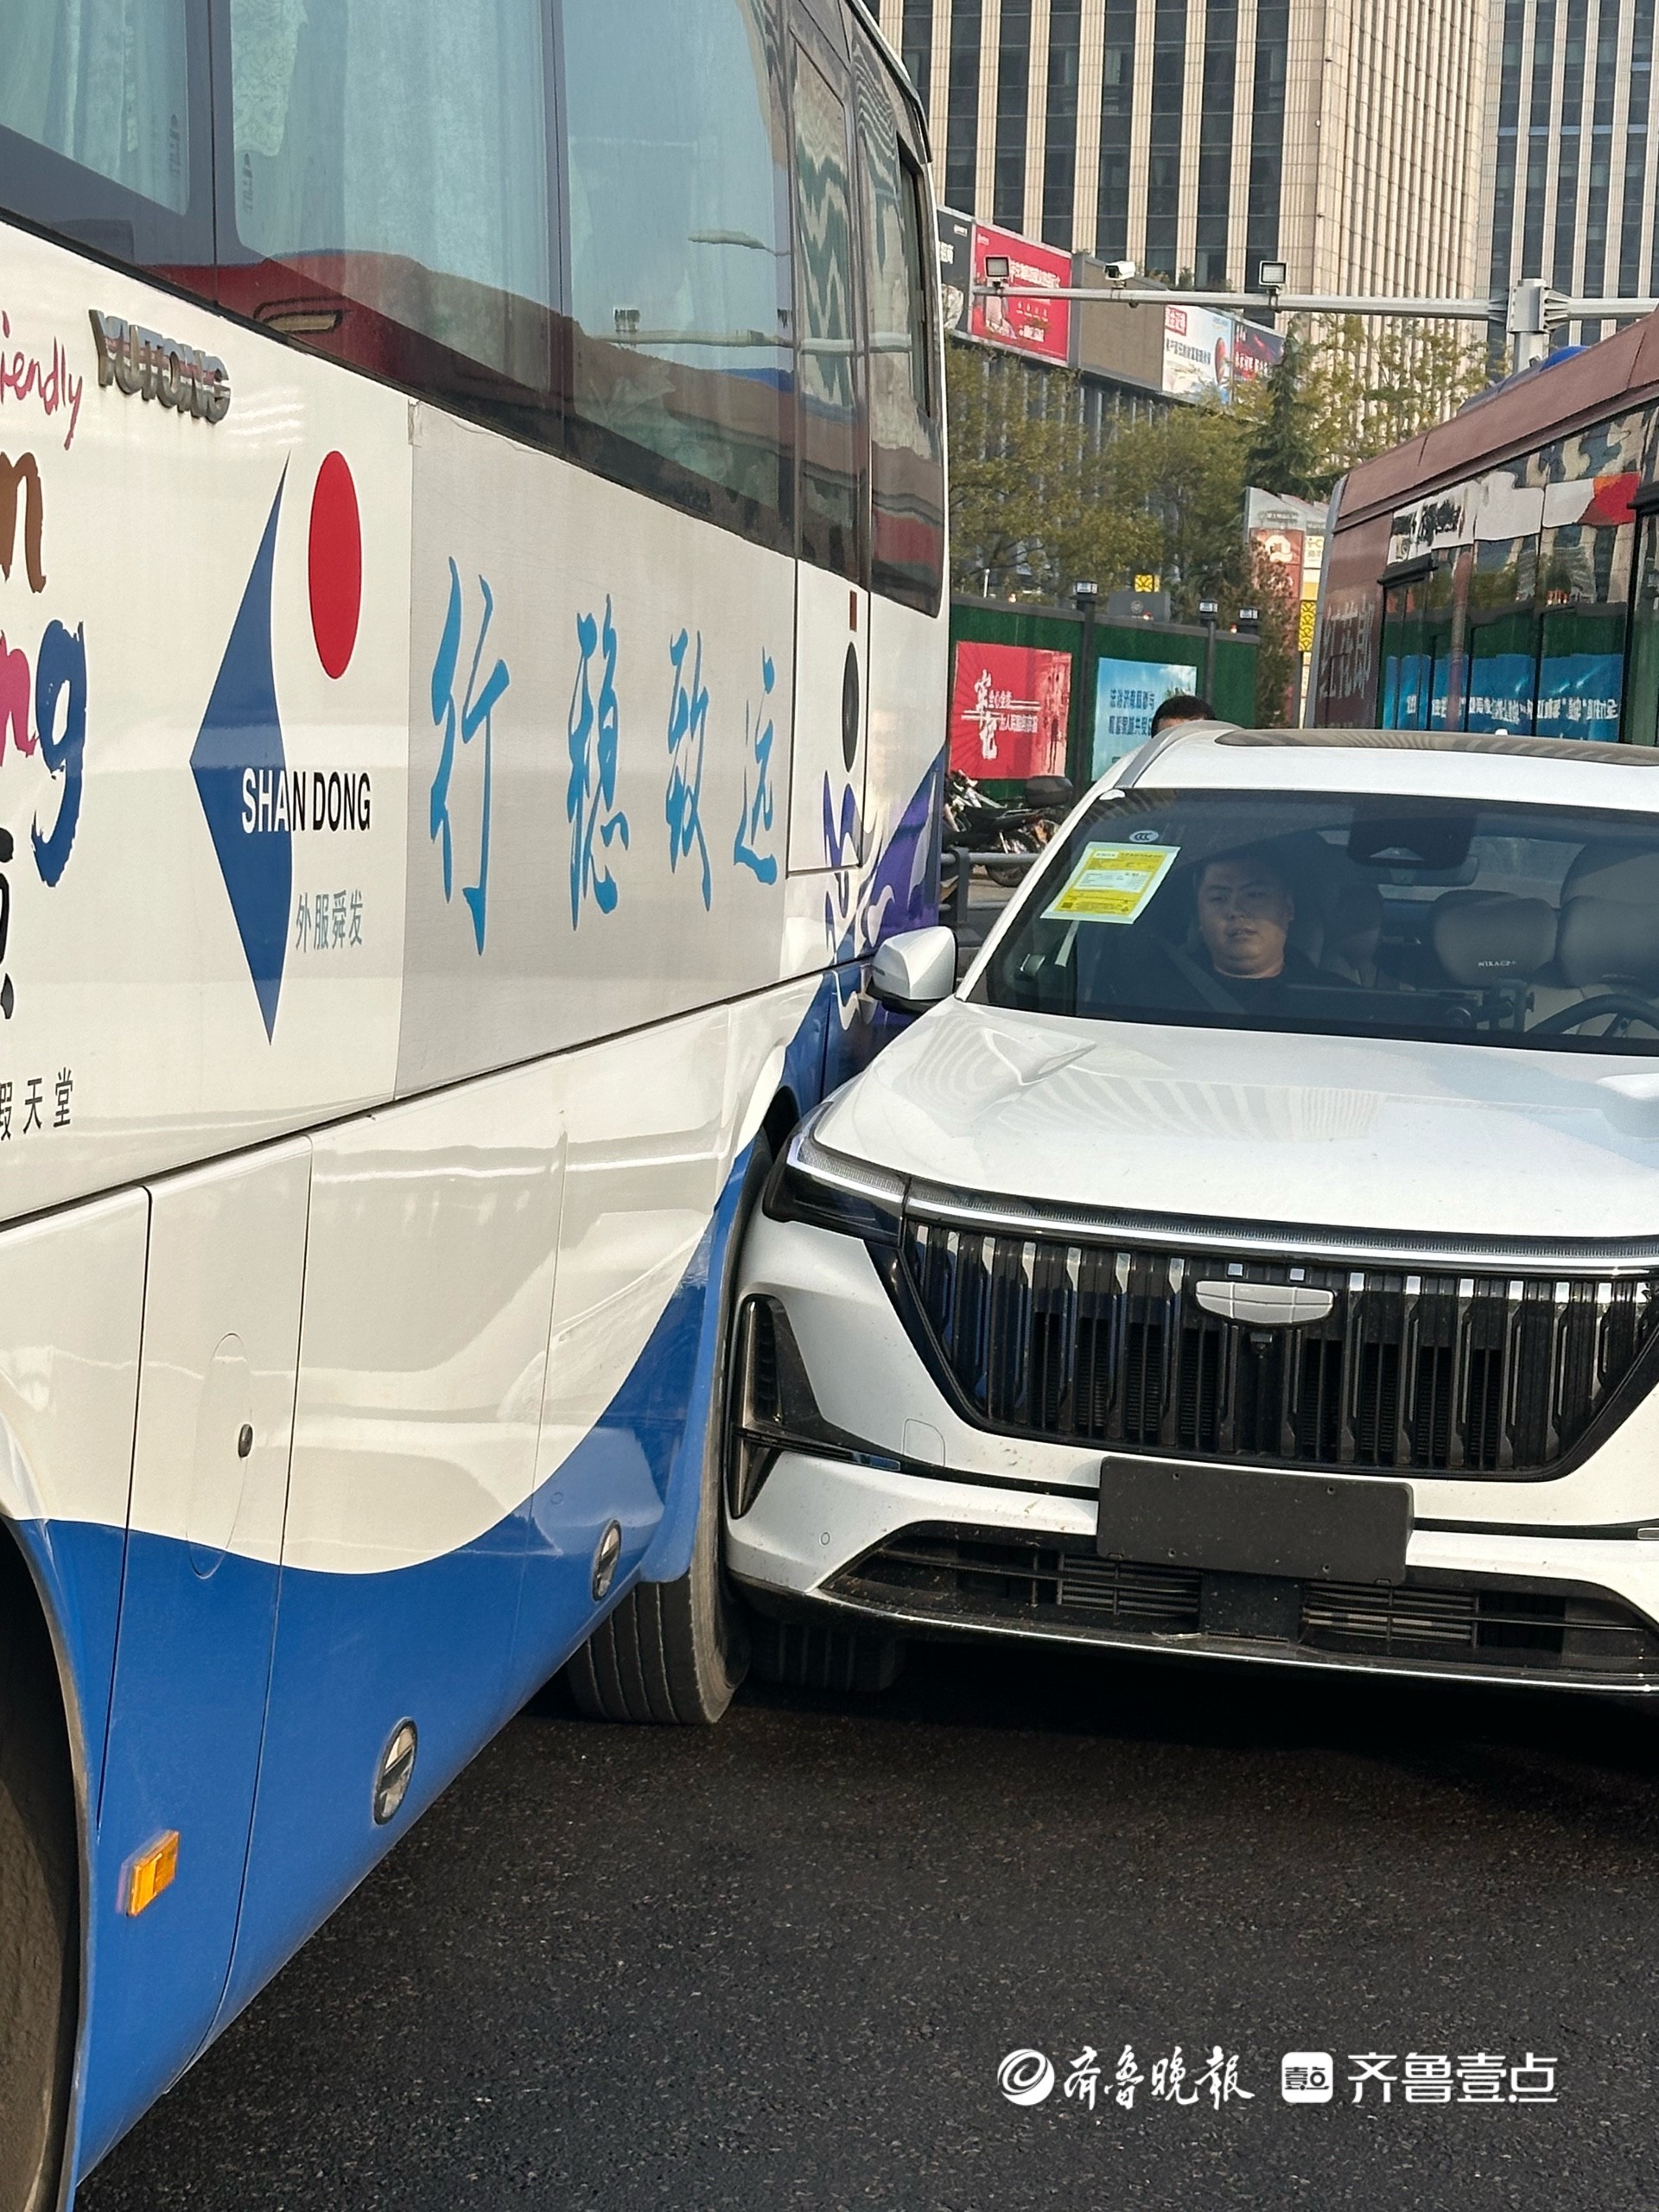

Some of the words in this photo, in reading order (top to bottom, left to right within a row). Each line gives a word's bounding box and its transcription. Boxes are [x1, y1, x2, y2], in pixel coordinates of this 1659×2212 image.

[89, 309, 231, 424] YUTONG
[295, 889, 363, 954] 外服舜发
